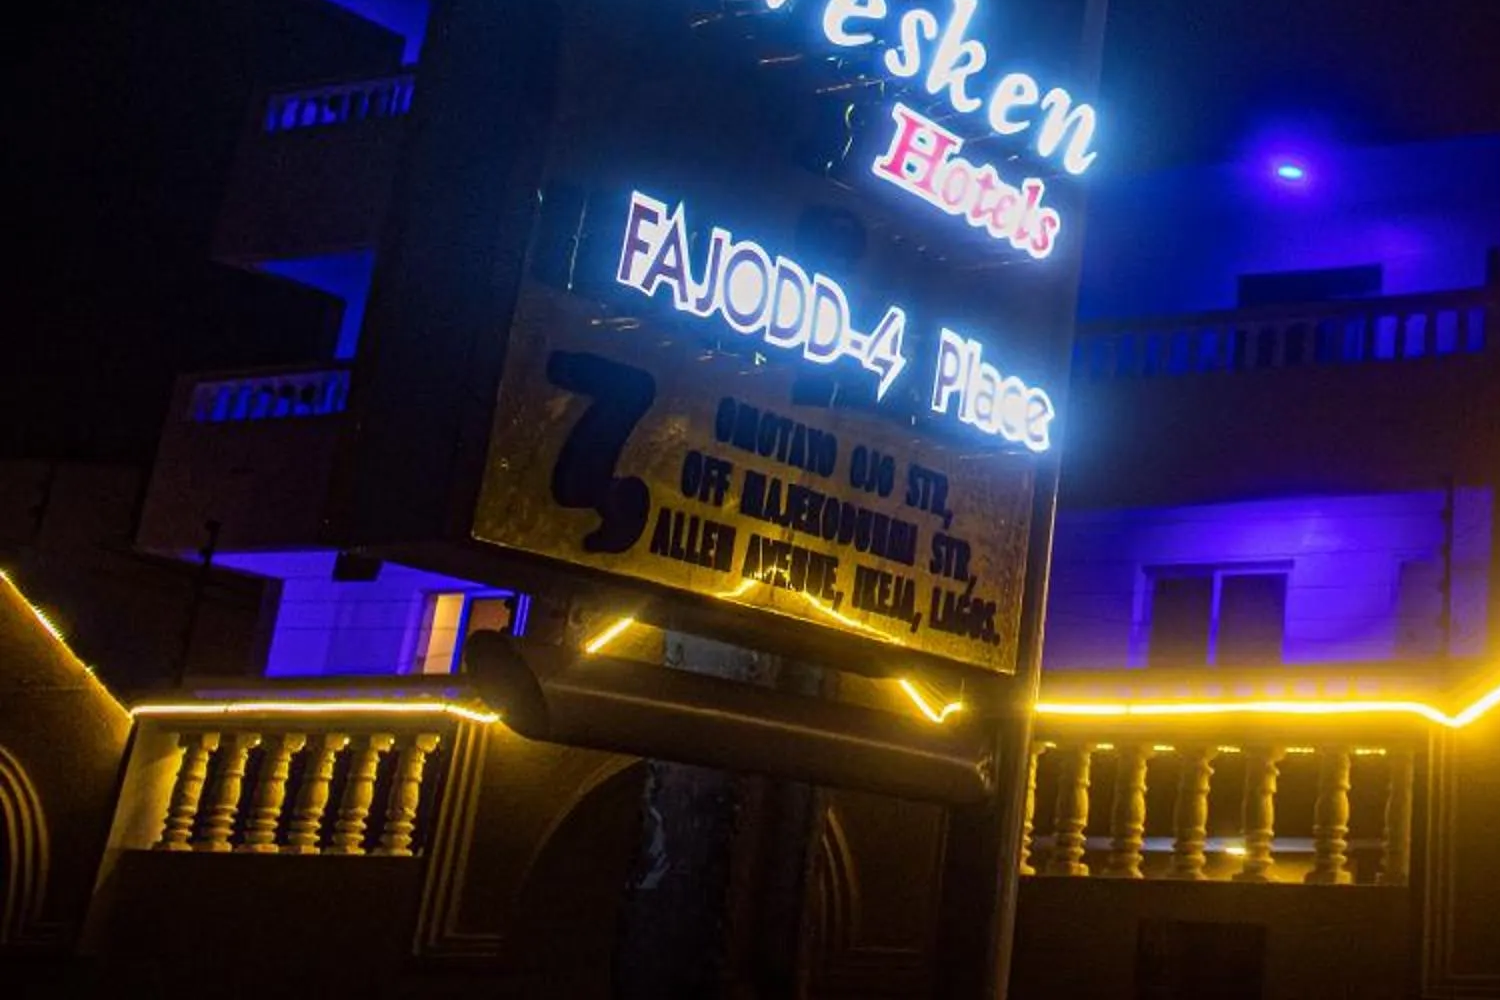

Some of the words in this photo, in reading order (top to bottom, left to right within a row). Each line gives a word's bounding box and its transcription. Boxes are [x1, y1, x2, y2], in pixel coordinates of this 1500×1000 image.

[872, 103, 1061, 258] Hotels
[615, 190, 906, 401] FAJODD-4
[931, 327, 1055, 452] Place
[681, 450, 734, 507] OFF
[650, 507, 737, 572] ALLEN
